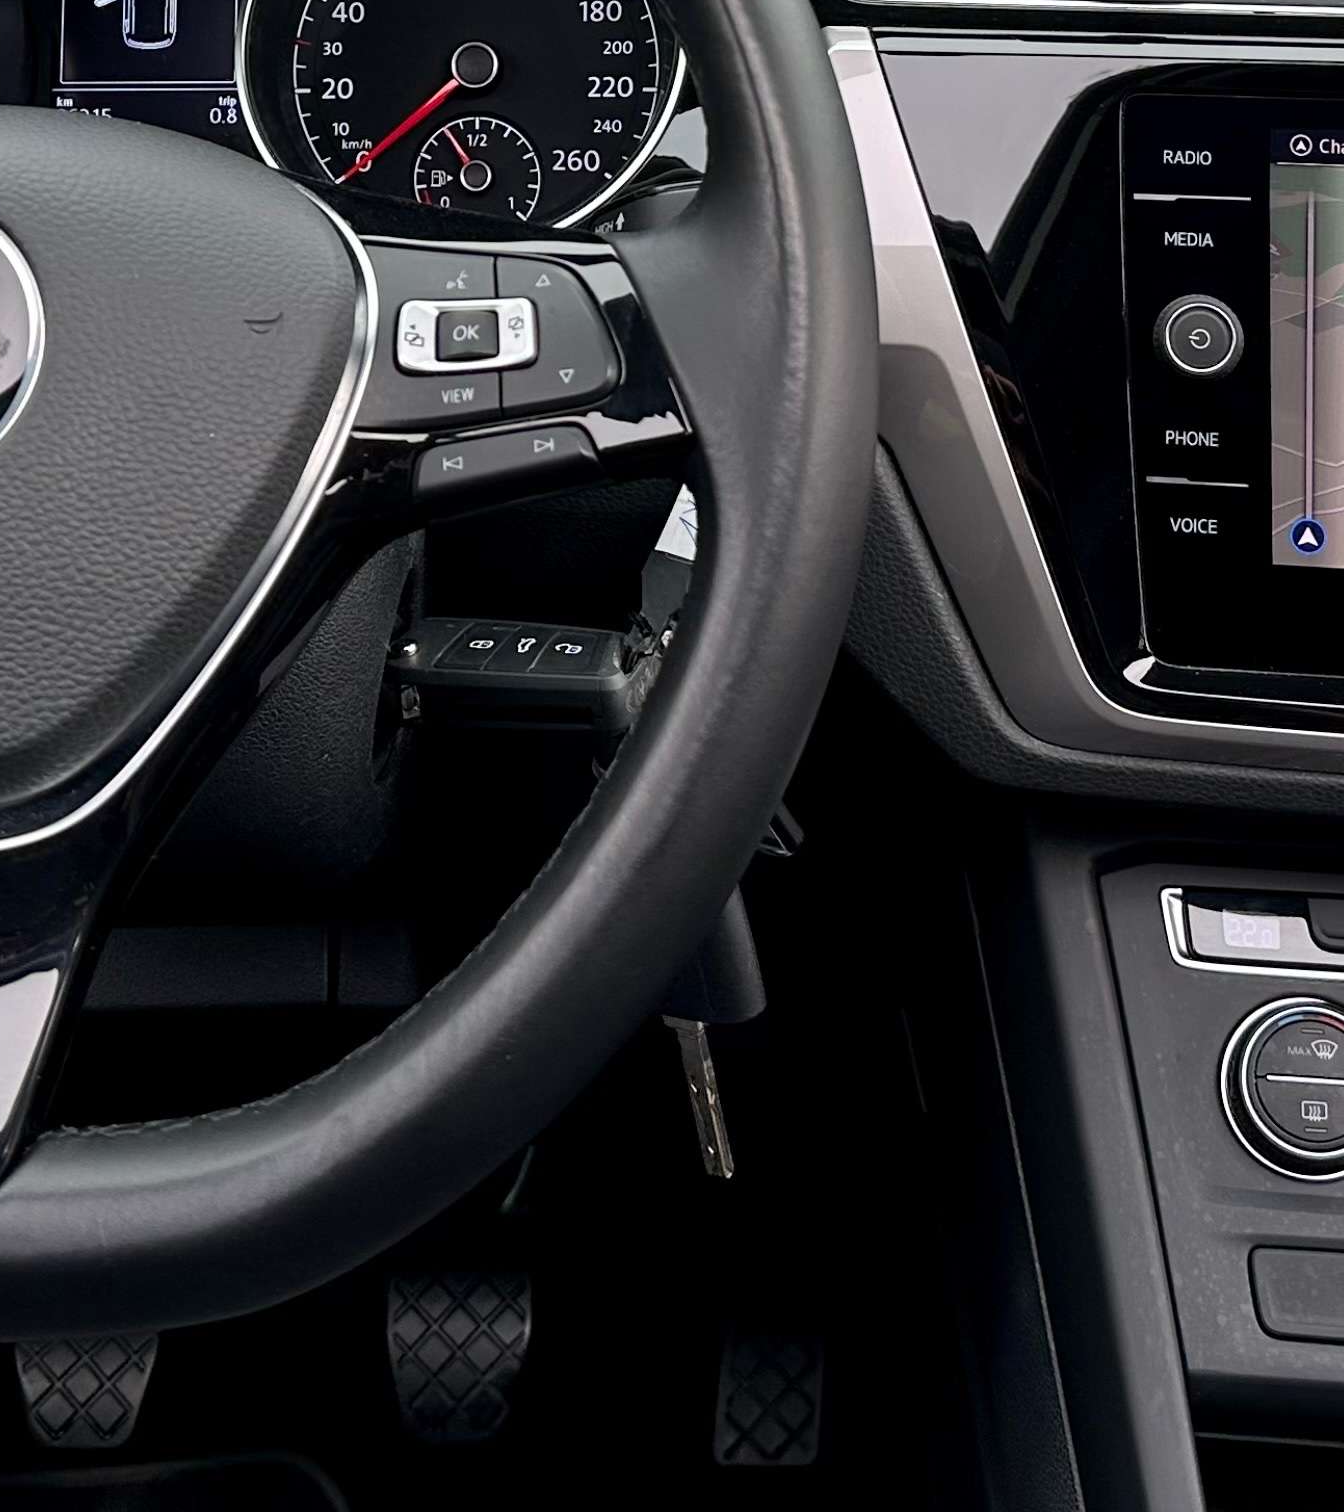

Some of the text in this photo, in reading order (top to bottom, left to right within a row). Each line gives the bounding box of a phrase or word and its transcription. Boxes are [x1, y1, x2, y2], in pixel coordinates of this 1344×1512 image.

[332, 2, 364, 23] 40
[579, 1, 622, 22] 180
[324, 42, 342, 55] 30
[603, 41, 633, 54] 200
[322, 78, 353, 99] 20
[588, 77, 633, 97] 220
[57, 97, 75, 110] km
[218, 95, 237, 108] trip
[210, 106, 237, 123] 0.8
[332, 122, 350, 137] 10
[594, 120, 622, 132] 240
[341, 138, 373, 152] km/h
[467, 134, 487, 146] 1/2
[553, 150, 599, 171] 260
[1164, 150, 1211, 165] RADIO
[1165, 232, 1213, 247] MEDIA
[453, 325, 478, 341] OK
[442, 388, 473, 403] VIEW
[1166, 430, 1218, 446] PHONE
[1170, 518, 1217, 534] VOICE
[1286, 1045, 1313, 1058] MAX
